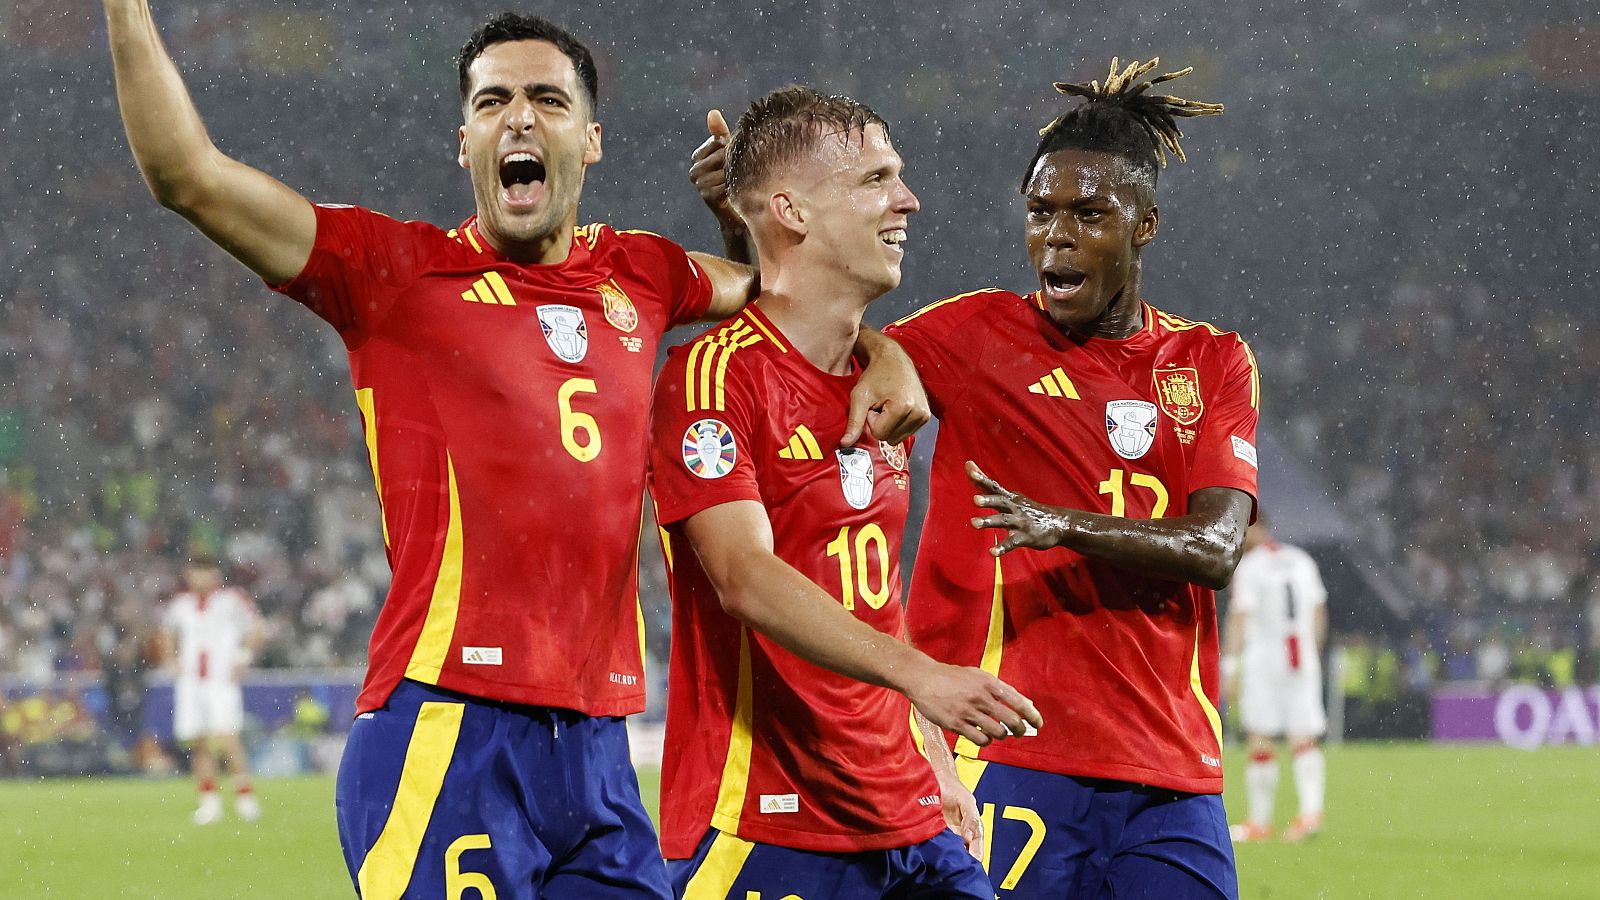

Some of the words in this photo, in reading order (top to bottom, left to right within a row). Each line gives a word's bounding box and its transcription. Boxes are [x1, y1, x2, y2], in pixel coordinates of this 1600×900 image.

[558, 377, 602, 463] 6
[1099, 468, 1169, 519] 17
[826, 523, 890, 611] 10
[609, 671, 637, 685] HEAT.RDY
[445, 833, 497, 900] 6
[980, 802, 1047, 891] 17
